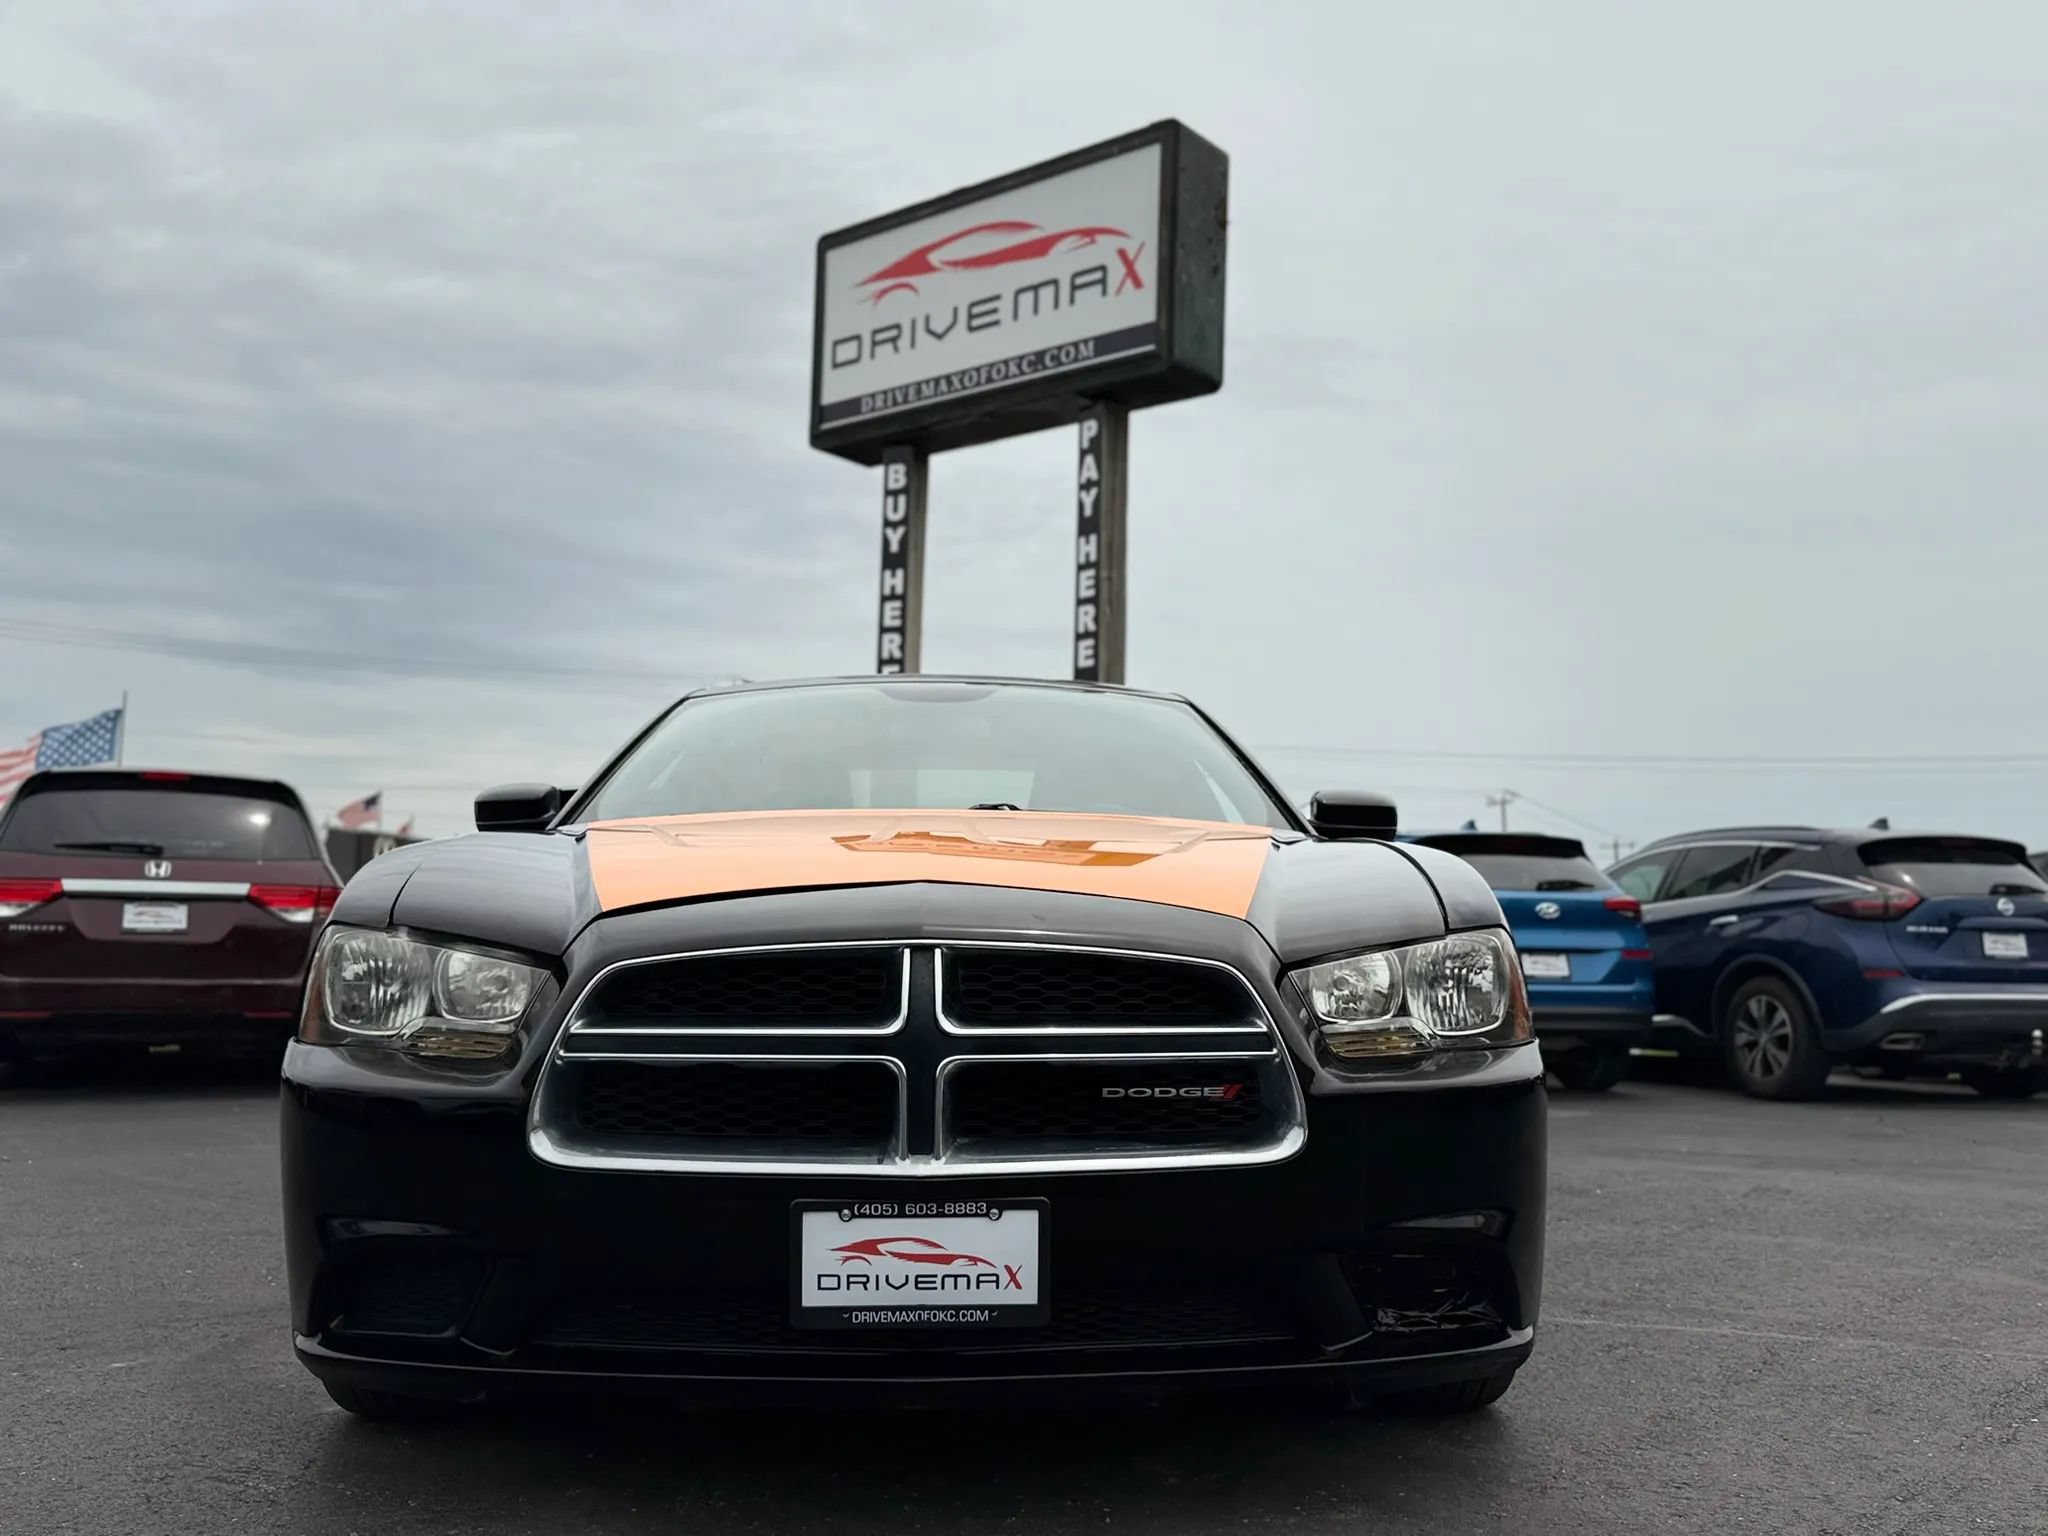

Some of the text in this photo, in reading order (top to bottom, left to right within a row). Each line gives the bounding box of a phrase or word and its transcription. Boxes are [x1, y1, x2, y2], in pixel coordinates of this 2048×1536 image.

[831, 241, 1146, 370] DRIVEMAX
[860, 340, 1096, 414] DRIVEMAXOFOKC.COM
[885, 463, 908, 553] BUY
[1076, 419, 1099, 669] PAY HERE
[1102, 1087, 1225, 1098] DODGE
[854, 1202, 987, 1216] (405) 603-8883
[817, 1264, 1023, 1292] DRIVEMAX
[851, 1309, 989, 1324] DRIVEMAXOFOKC.COM
